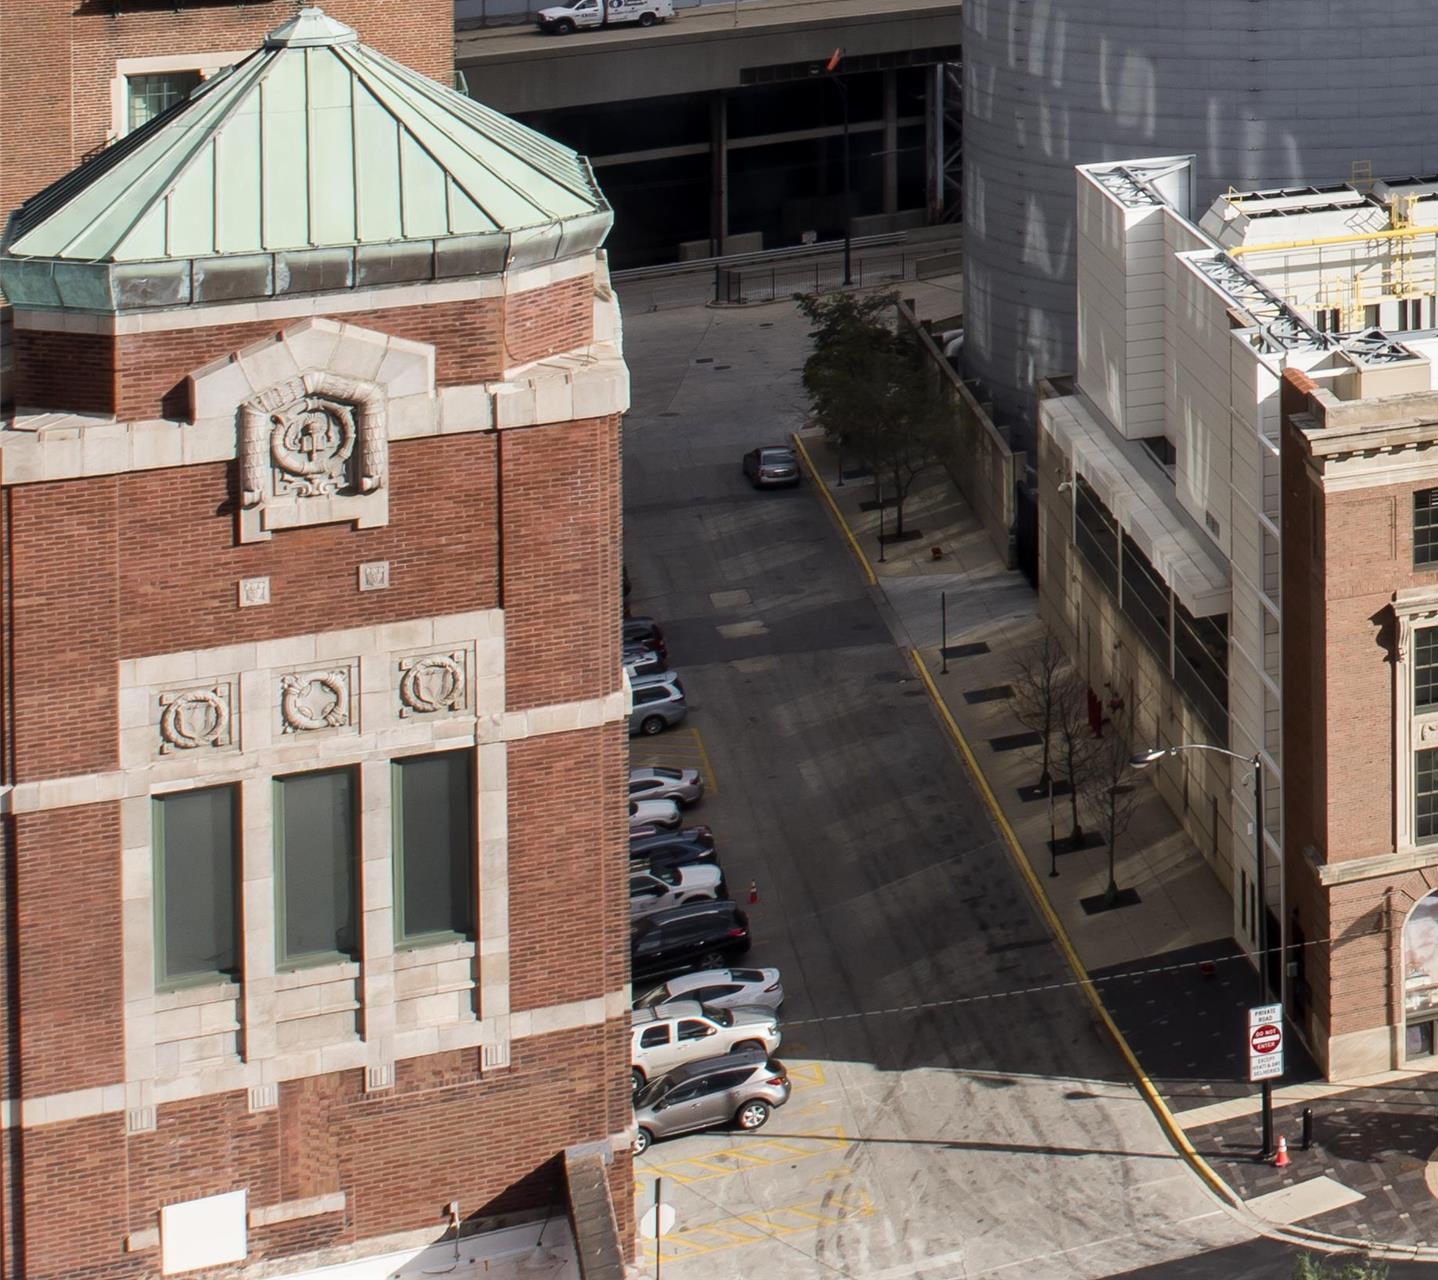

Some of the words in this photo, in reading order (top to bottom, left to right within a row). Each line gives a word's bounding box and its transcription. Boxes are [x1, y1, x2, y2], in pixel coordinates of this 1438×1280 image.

[1255, 1008, 1276, 1017] PRIVATE
[1265, 1028, 1277, 1036] NOT
[1257, 1041, 1276, 1050] ENTER
